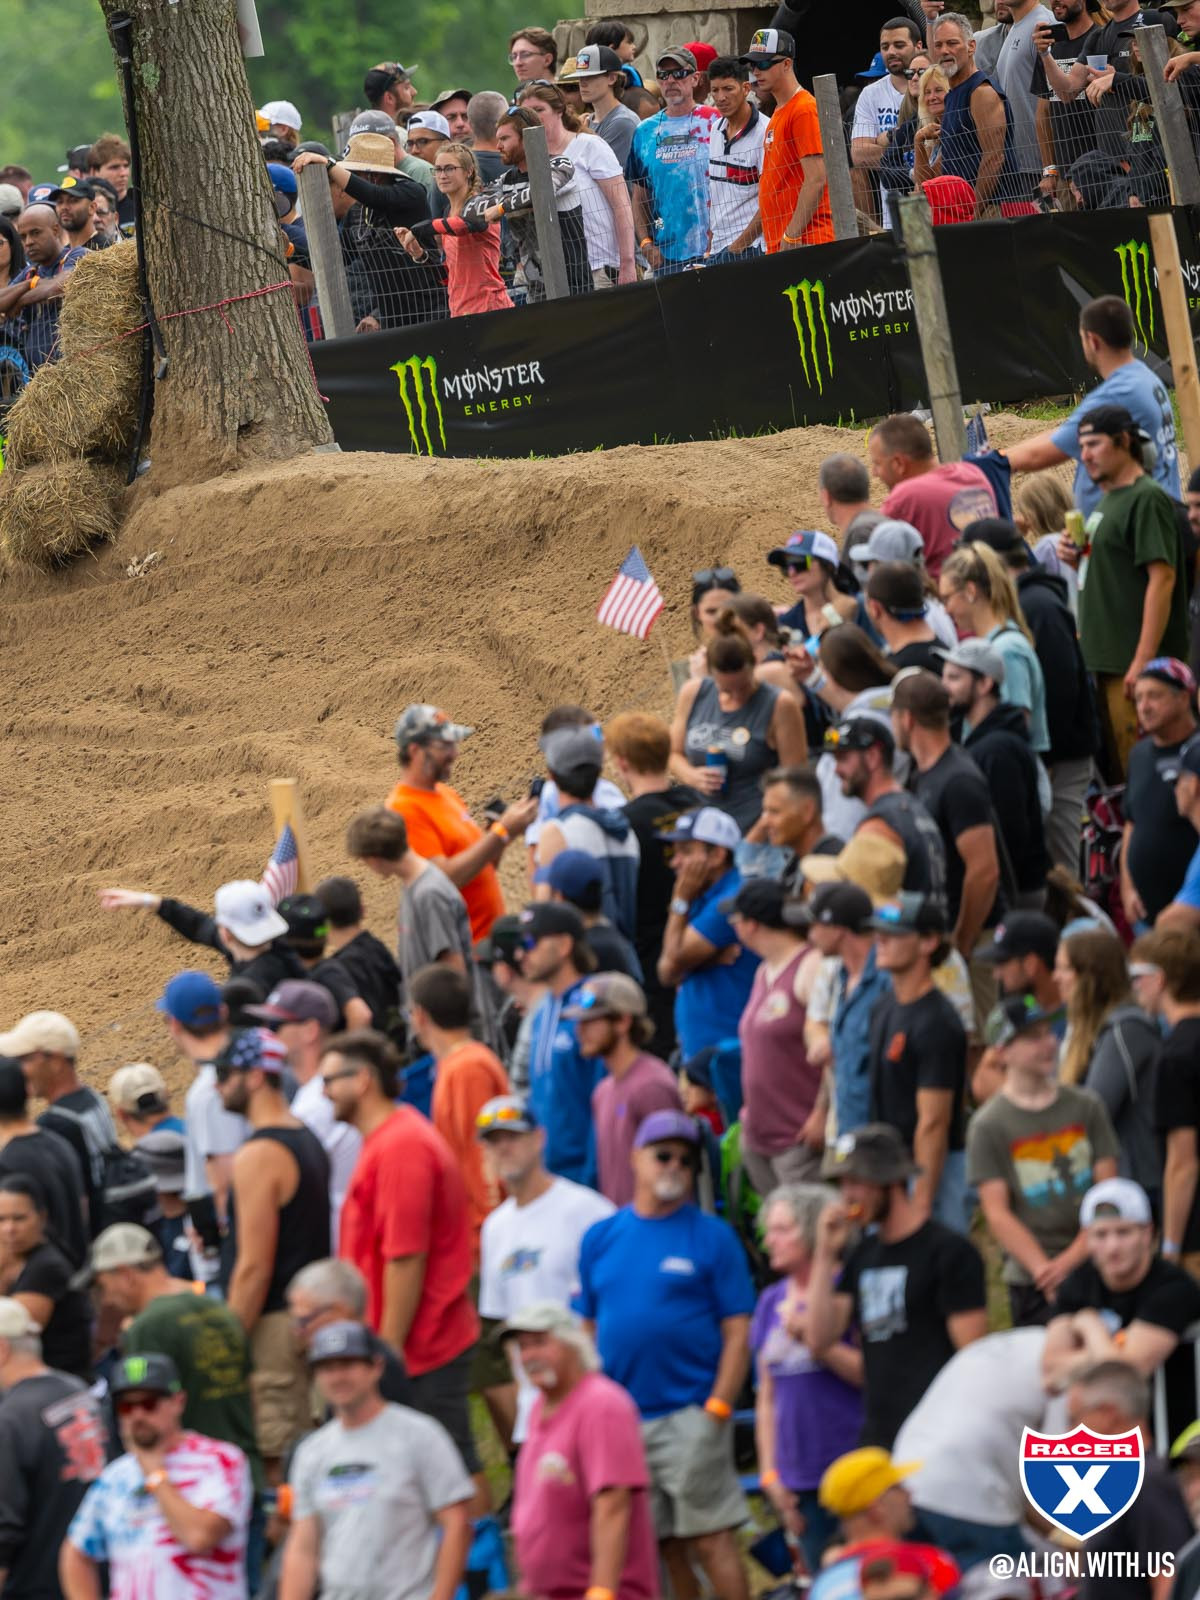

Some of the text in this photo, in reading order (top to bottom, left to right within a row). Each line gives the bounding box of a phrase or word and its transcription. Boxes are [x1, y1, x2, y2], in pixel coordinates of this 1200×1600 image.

[511, 187, 531, 209] FO
[849, 322, 910, 341] ENERGY
[442, 361, 545, 400] MONSTER
[464, 394, 533, 416] ENERGY
